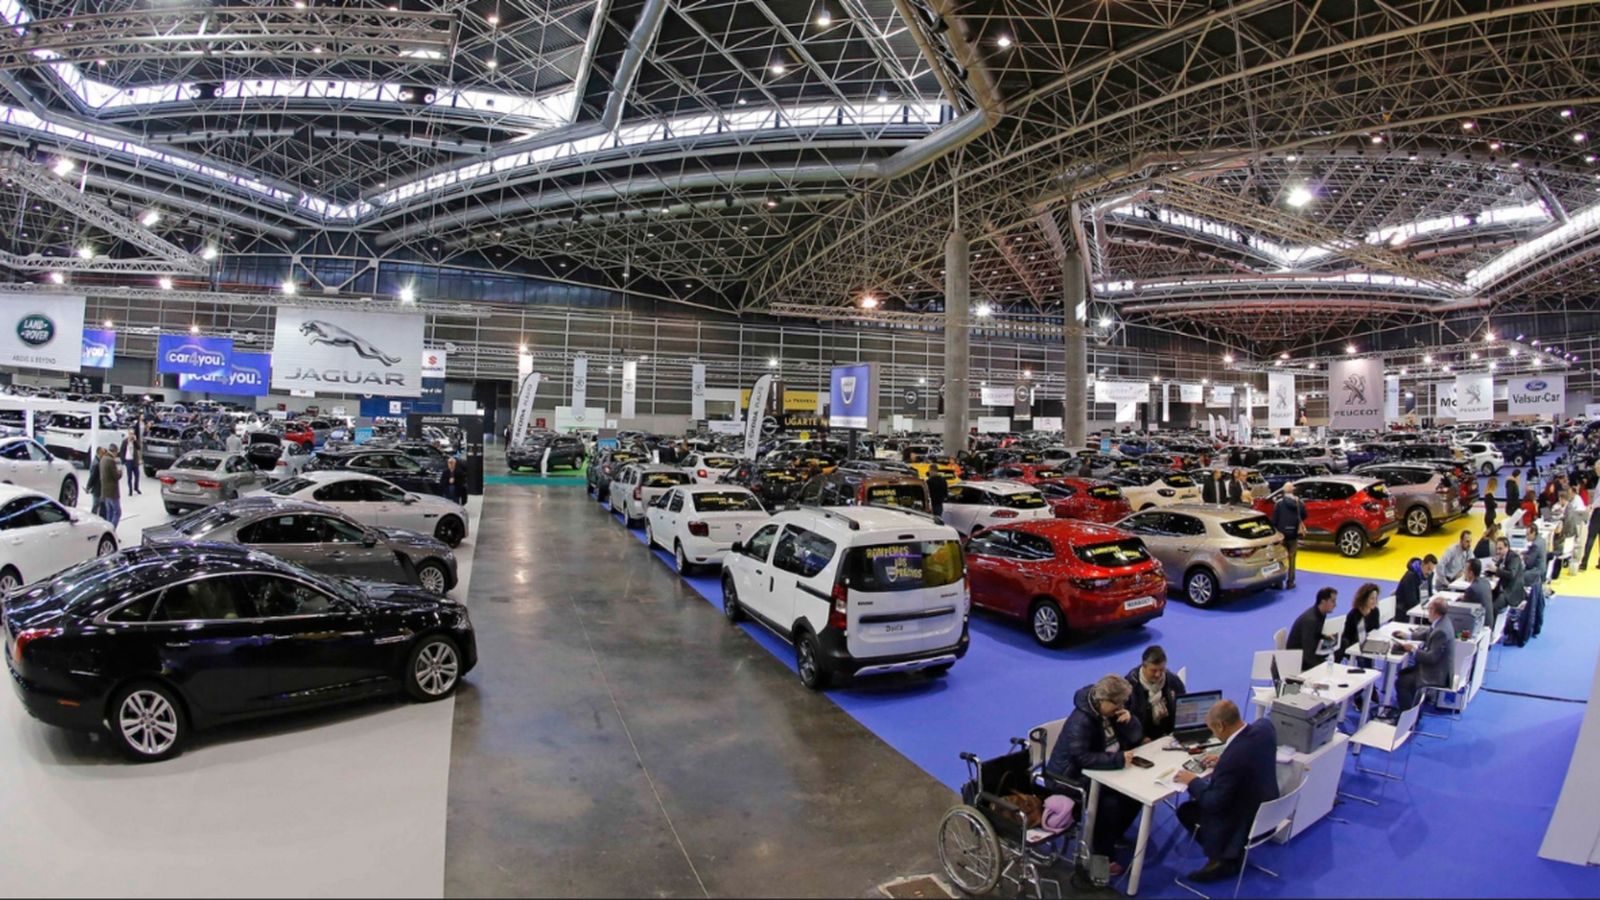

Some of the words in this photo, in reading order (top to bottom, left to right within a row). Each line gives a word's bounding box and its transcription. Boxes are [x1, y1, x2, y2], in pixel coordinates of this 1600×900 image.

[23, 320, 44, 330] LAND
[24, 330, 49, 341] ROVER
[285, 367, 405, 387] JAGUAR
[1512, 391, 1560, 404] Valsur-Car
[1334, 408, 1379, 417] PEUGEOT
[784, 417, 817, 426] UGARTE
